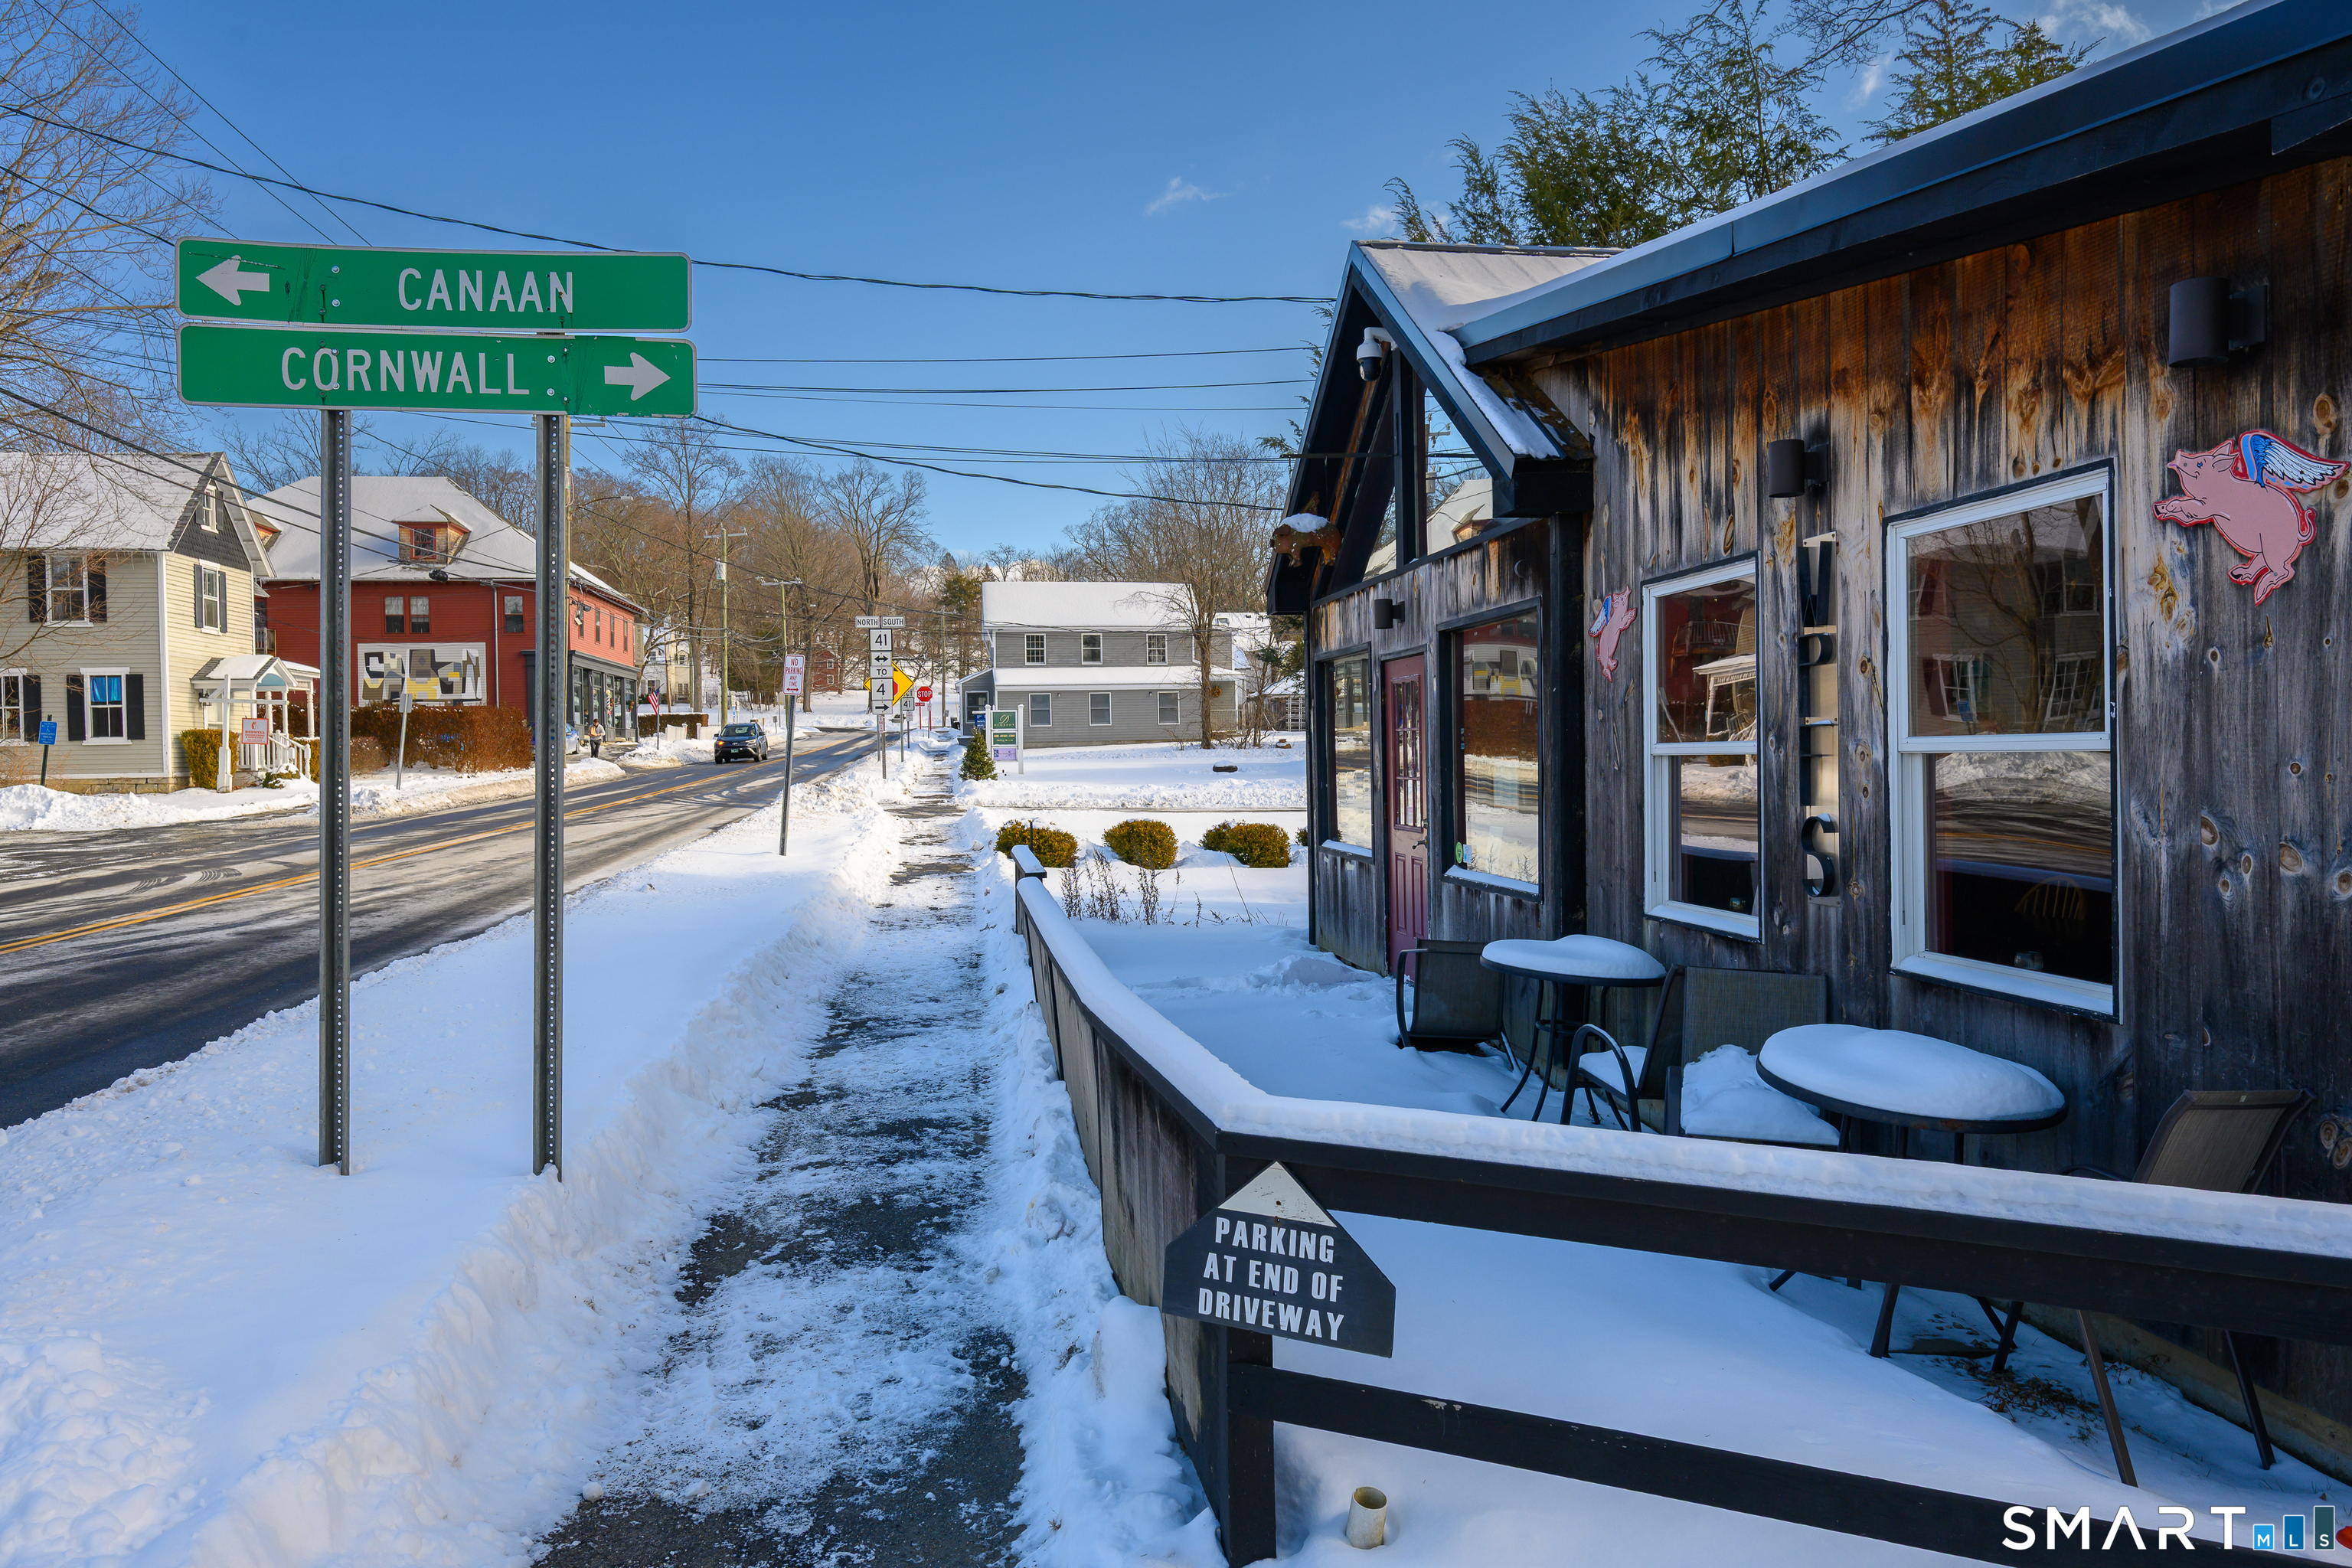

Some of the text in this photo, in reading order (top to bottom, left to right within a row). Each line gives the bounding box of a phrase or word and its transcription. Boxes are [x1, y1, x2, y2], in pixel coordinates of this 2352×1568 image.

[398, 267, 573, 313] CANAAN
[281, 346, 530, 394] CORNWALL
[874, 633, 887, 646] 41
[876, 683, 885, 695] 4
[903, 700, 911, 708] 41
[1215, 1217, 1335, 1264] PARKING
[1203, 1252, 1344, 1302] AT END OF
[1197, 1287, 1344, 1341] DRIVEWAY
